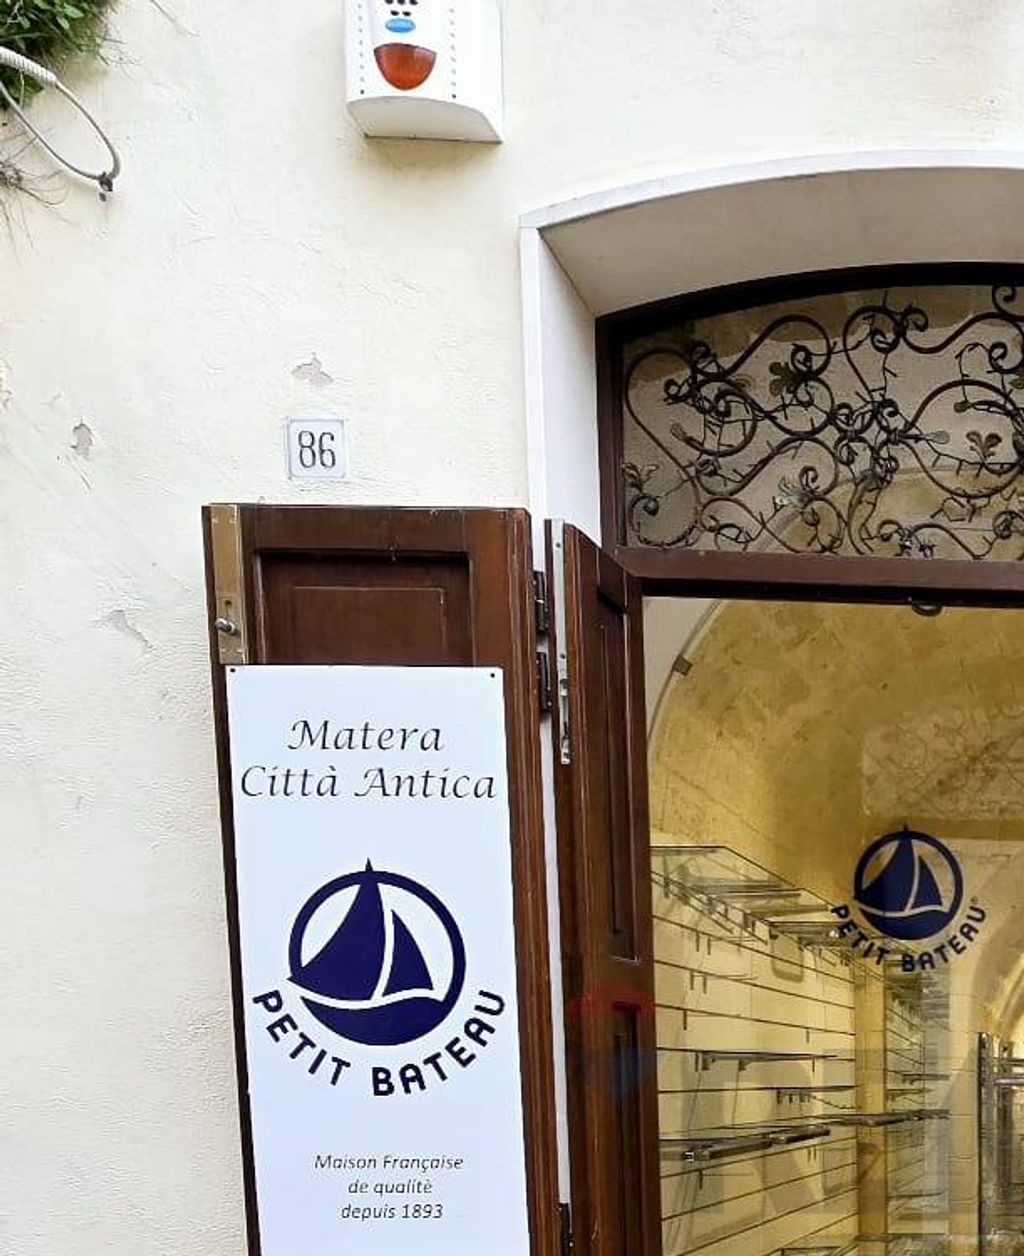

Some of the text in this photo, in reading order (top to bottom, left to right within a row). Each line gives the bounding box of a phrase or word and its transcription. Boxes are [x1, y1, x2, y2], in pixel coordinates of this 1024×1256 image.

[297, 430, 336, 468] 86
[287, 720, 443, 751] Matera
[240, 766, 496, 799] Città Antica
[831, 905, 986, 972] PETIT BATEAU
[253, 990, 505, 1096] PETIT BATEAU
[314, 1154, 464, 1174] Maison Française
[348, 1179, 369, 1193] de
[341, 1203, 444, 1222] depuis 1893
